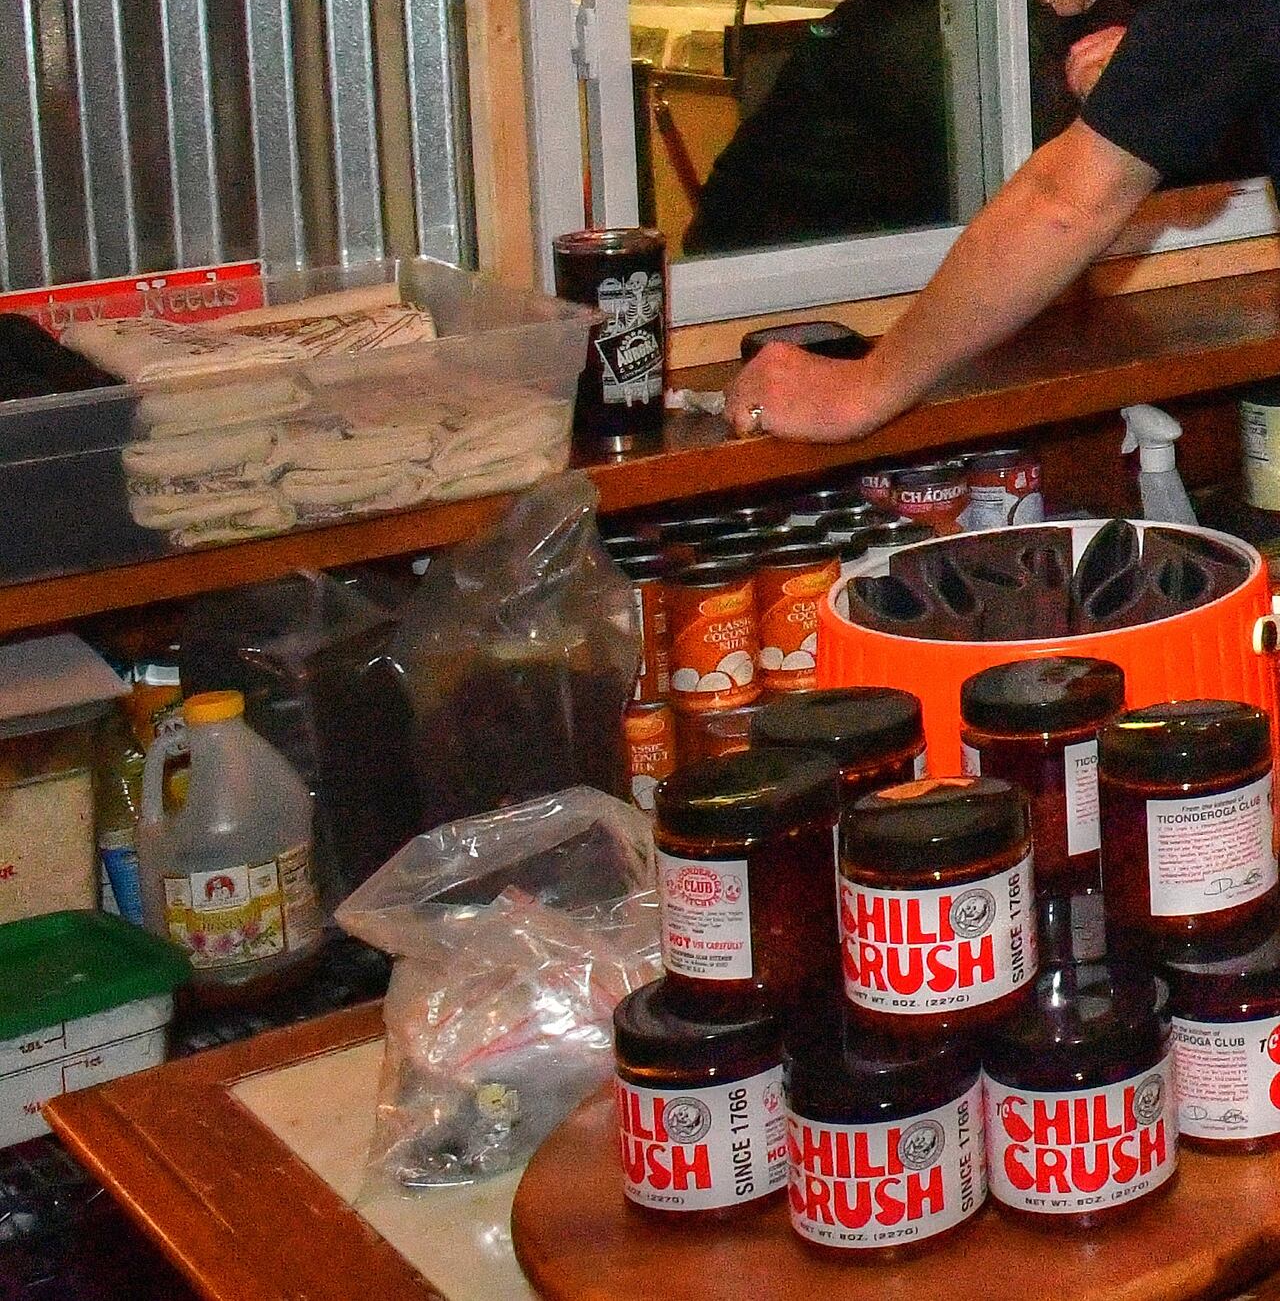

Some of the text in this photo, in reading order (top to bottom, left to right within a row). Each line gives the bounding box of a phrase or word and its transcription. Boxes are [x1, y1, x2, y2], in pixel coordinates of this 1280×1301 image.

[1156, 796, 1261, 824] TICONDEROGA CLUB
[684, 880, 713, 894] CLUB
[841, 885, 955, 945] CHILI
[668, 932, 692, 950] HOT
[842, 934, 995, 995] CRUSH
[1010, 924, 1024, 984] SINCE
[1214, 1037, 1246, 1048] CLUB
[729, 1088, 754, 1196] SINCE 1766
[1001, 1085, 1138, 1146] CHILI
[959, 1152, 974, 1213] SINCE
[1004, 1118, 1166, 1194] CRUSH
[788, 1165, 945, 1229] CRUSH
[1024, 1197, 1046, 1207] NET
